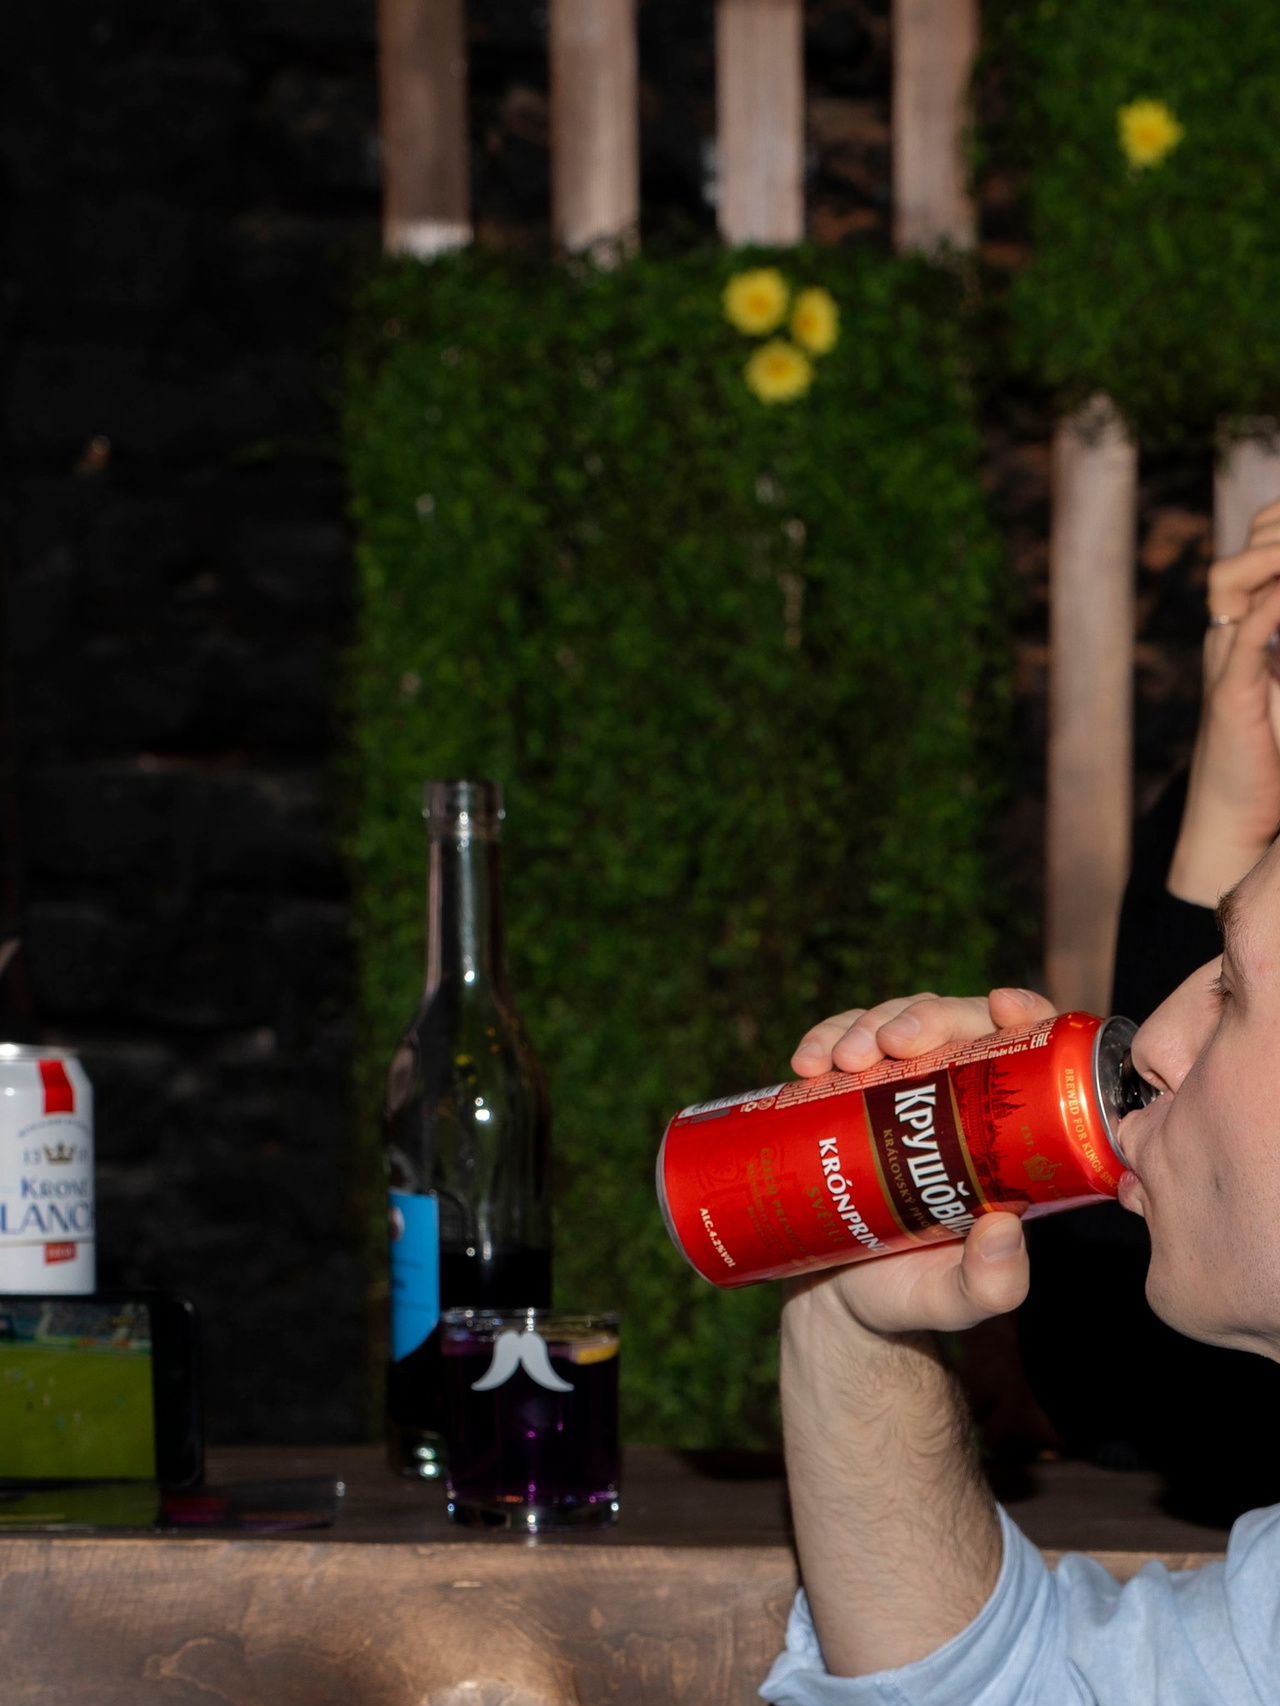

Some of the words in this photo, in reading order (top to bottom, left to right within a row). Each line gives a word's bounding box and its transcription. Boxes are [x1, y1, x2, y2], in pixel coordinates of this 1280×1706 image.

[1065, 1068, 1079, 1115] BREWED
[1073, 1117, 1088, 1142] FOR
[1082, 1141, 1104, 1174] KINGS
